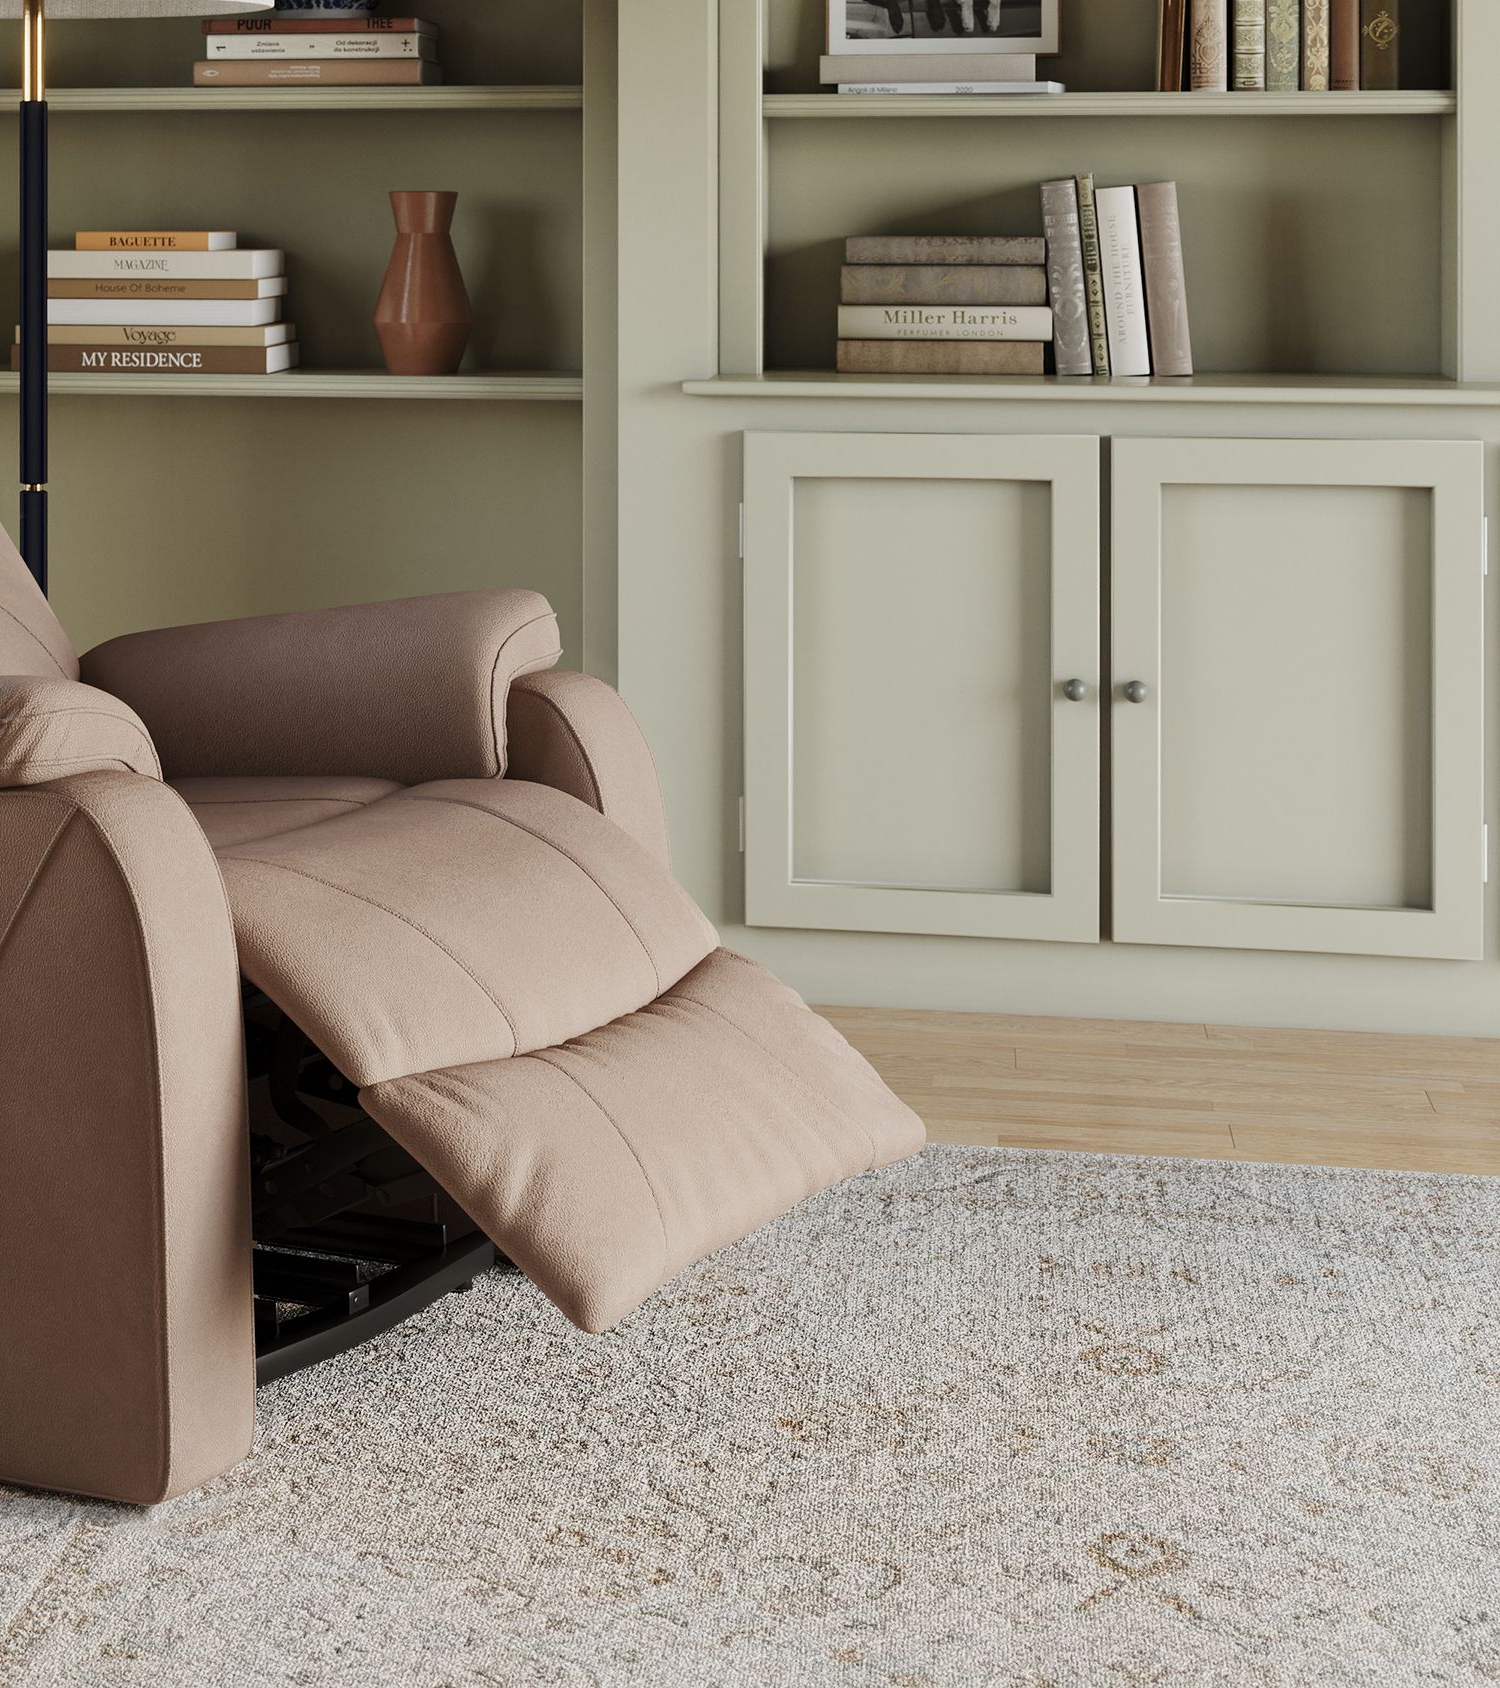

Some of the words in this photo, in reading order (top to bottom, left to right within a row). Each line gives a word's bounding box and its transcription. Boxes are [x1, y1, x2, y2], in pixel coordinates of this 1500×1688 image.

[237, 19, 272, 31] PUUR
[366, 18, 393, 29] THEE
[109, 237, 176, 247] BAGUETTE
[1108, 215, 1120, 257] HOUSE
[114, 259, 169, 271] MAGAZINE
[1112, 264, 1121, 286] THE
[1121, 245, 1134, 315] FURNITURE
[95, 283, 127, 293] House
[129, 283, 142, 293] Of
[145, 283, 186, 293] Boheme
[884, 310, 946, 324] Miller
[952, 311, 1018, 325] Harris
[1116, 292, 1126, 344] AROUND
[123, 327, 176, 345] Voyage
[897, 329, 950, 337] PERFUMER
[81, 352, 107, 367] MY
[111, 352, 202, 368] RESIDENCE
